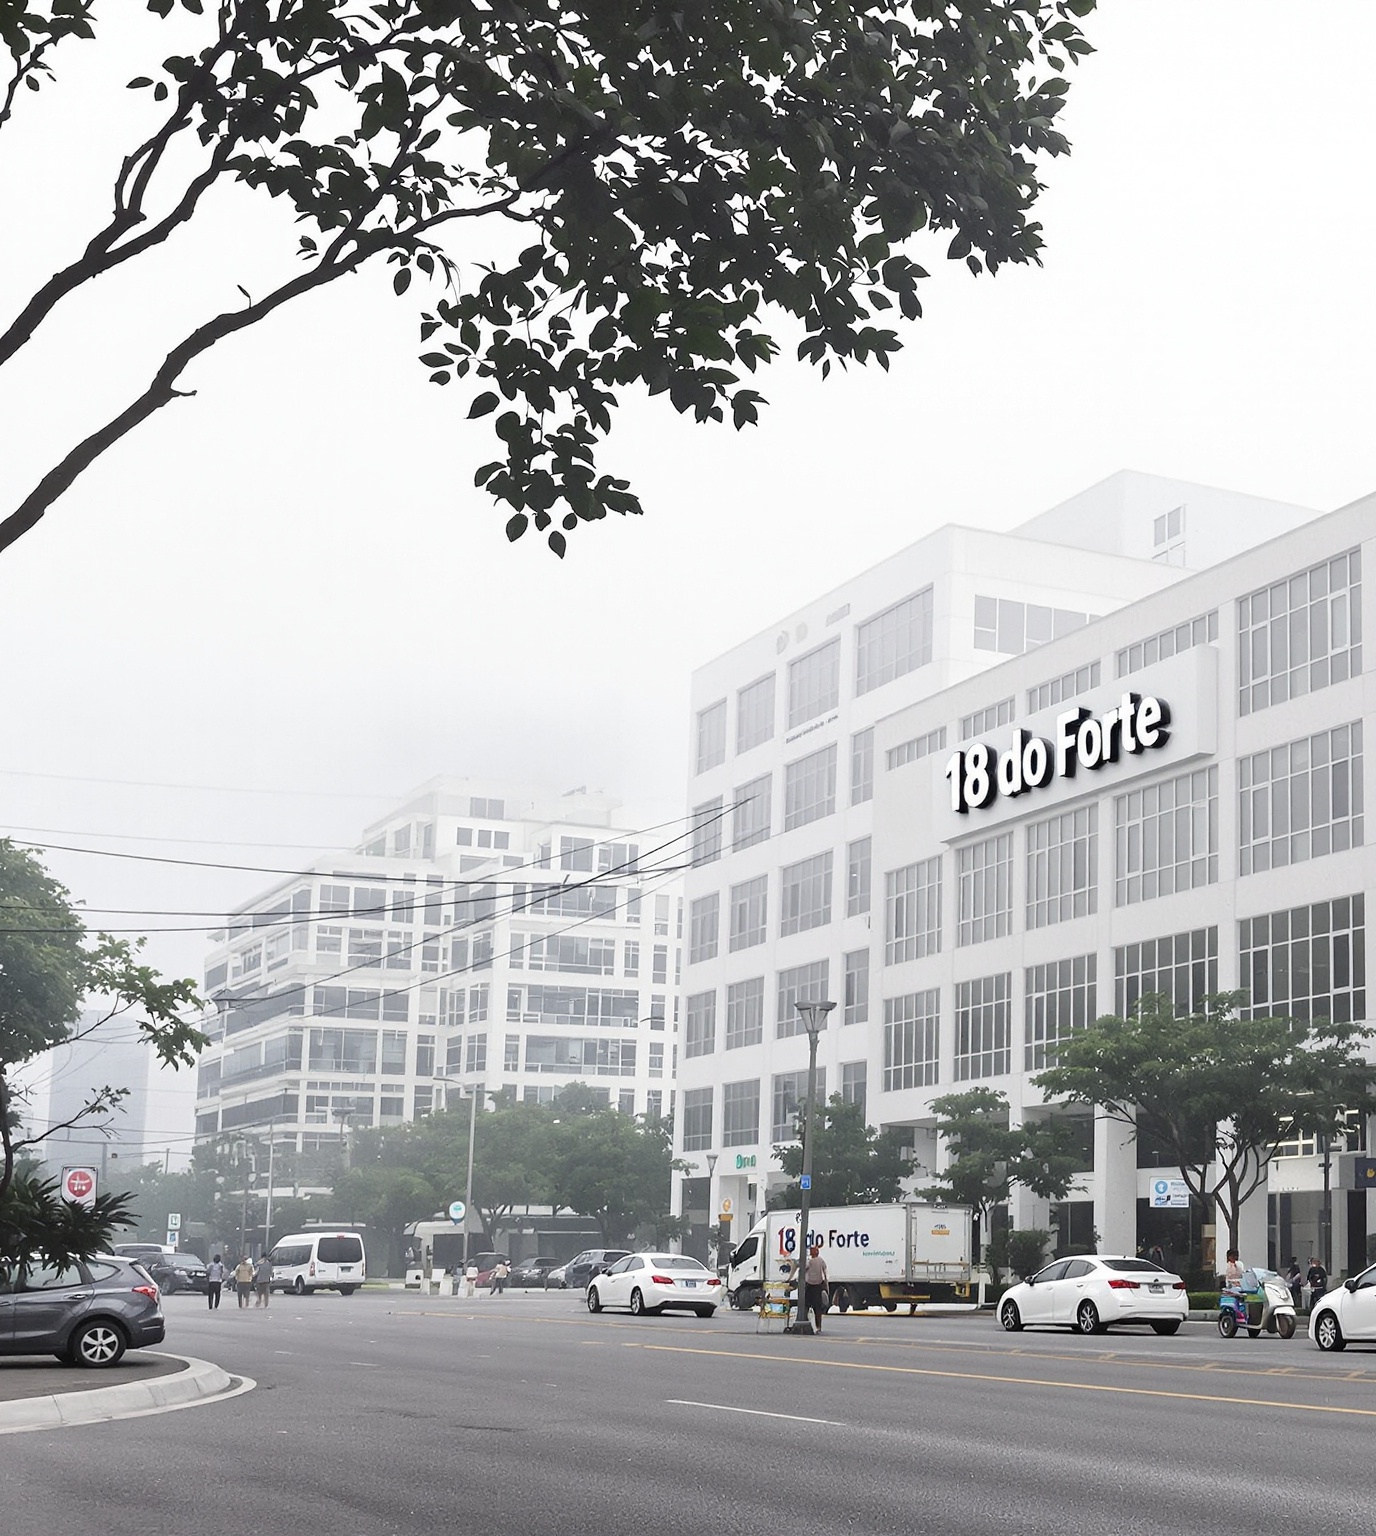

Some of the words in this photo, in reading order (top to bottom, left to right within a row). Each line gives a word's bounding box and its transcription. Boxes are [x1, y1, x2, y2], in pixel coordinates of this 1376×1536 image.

[945, 743, 995, 812] 18
[998, 728, 1053, 797] do
[1056, 692, 1169, 778] Forte
[778, 1226, 796, 1257] 18
[805, 1229, 824, 1248] do
[828, 1230, 870, 1248] Forte
